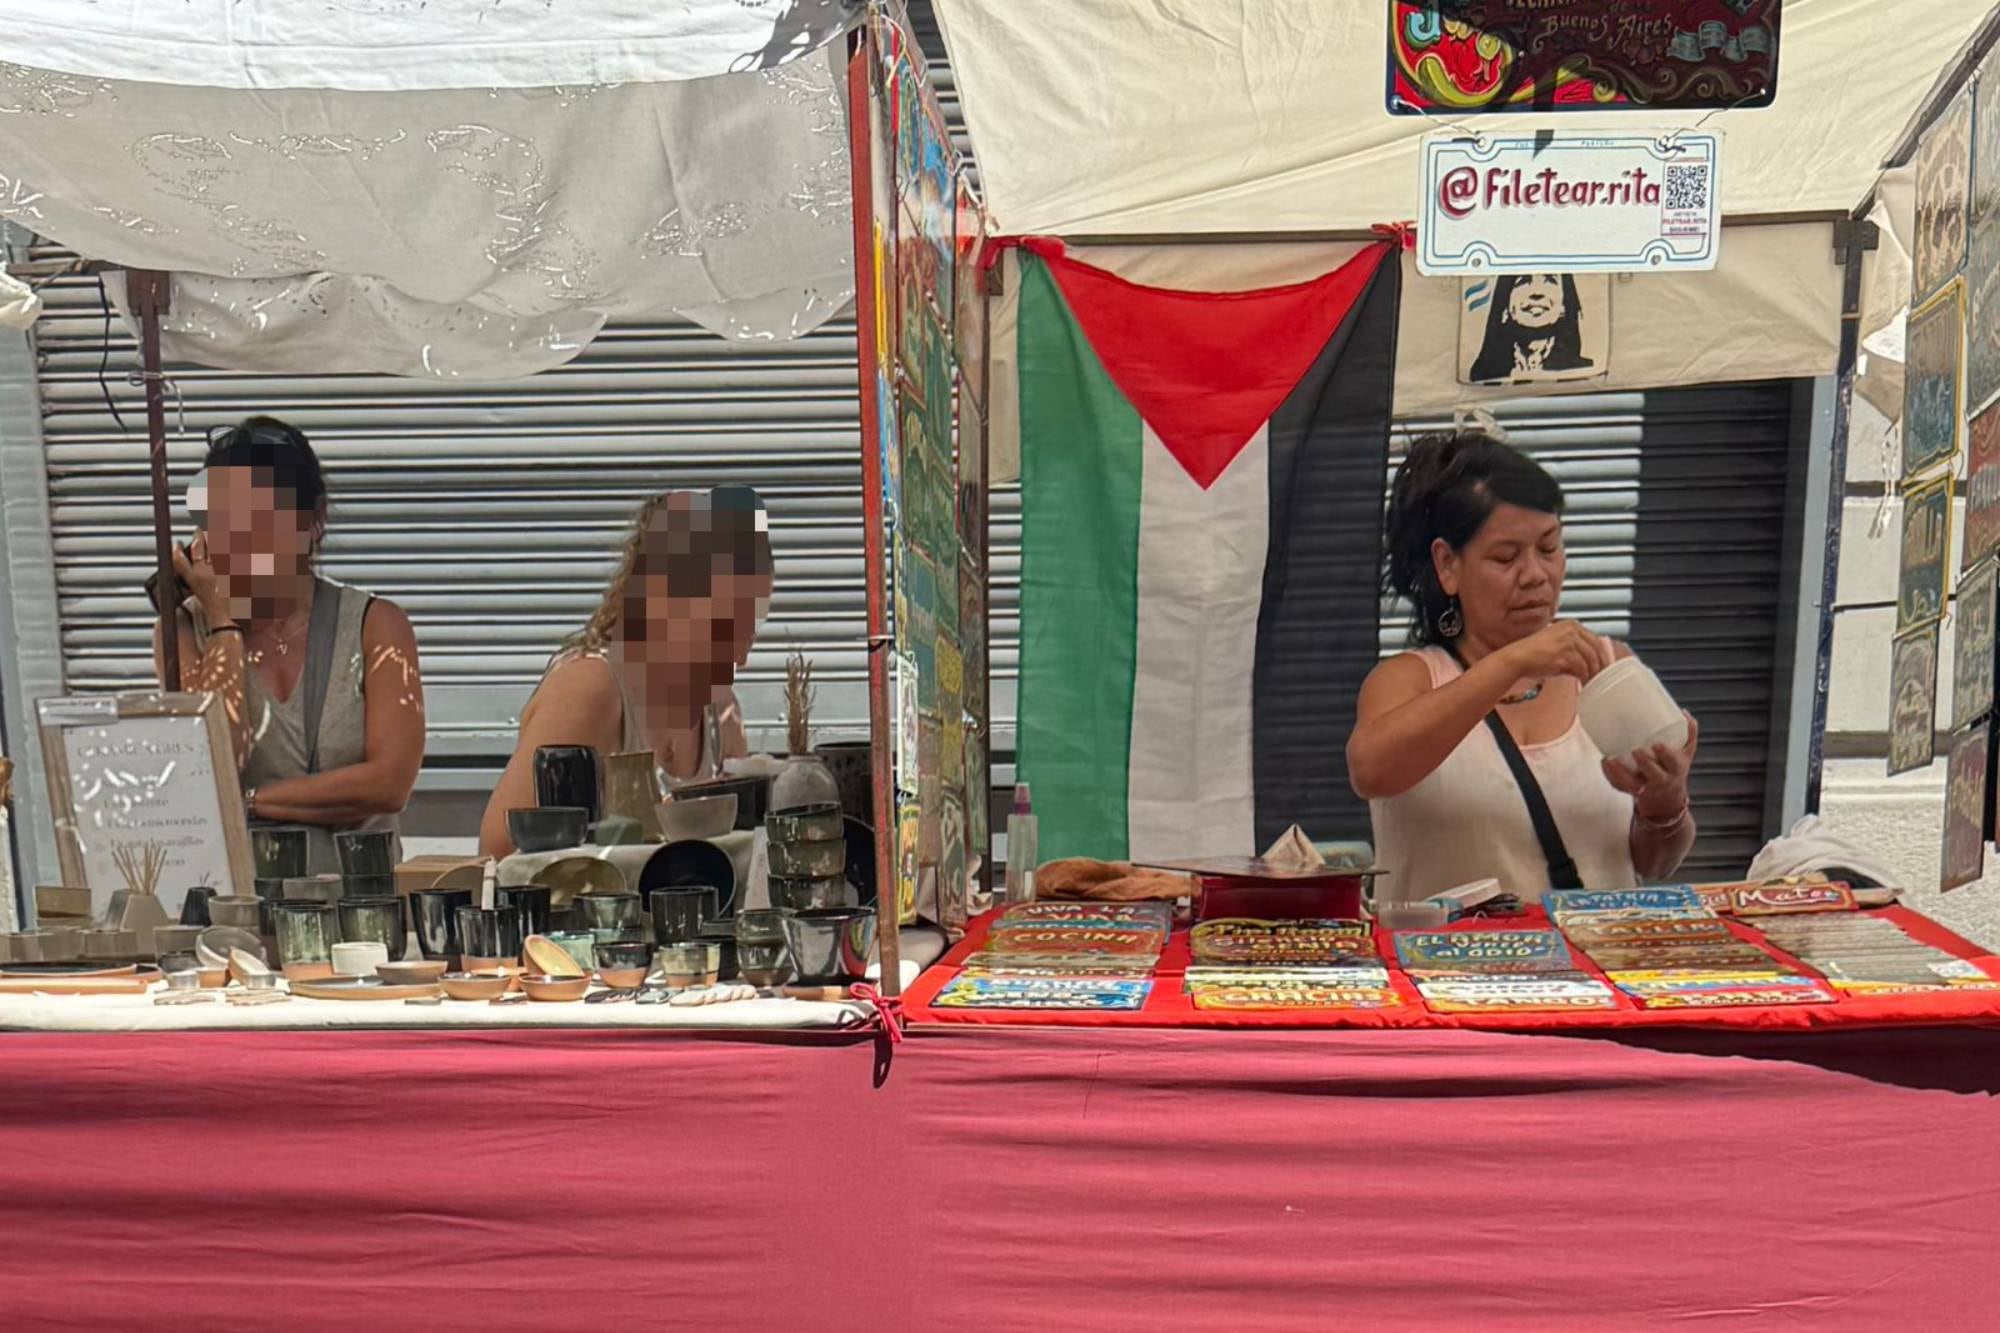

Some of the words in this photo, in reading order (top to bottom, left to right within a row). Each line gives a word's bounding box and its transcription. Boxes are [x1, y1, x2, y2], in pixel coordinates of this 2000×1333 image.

[1533, 13, 1609, 49] Buenos
[1608, 13, 1673, 49] Aires
[1416, 936, 1442, 947] EL
[1450, 933, 1543, 944] AMOR
[1467, 947, 1532, 957] ODIO
